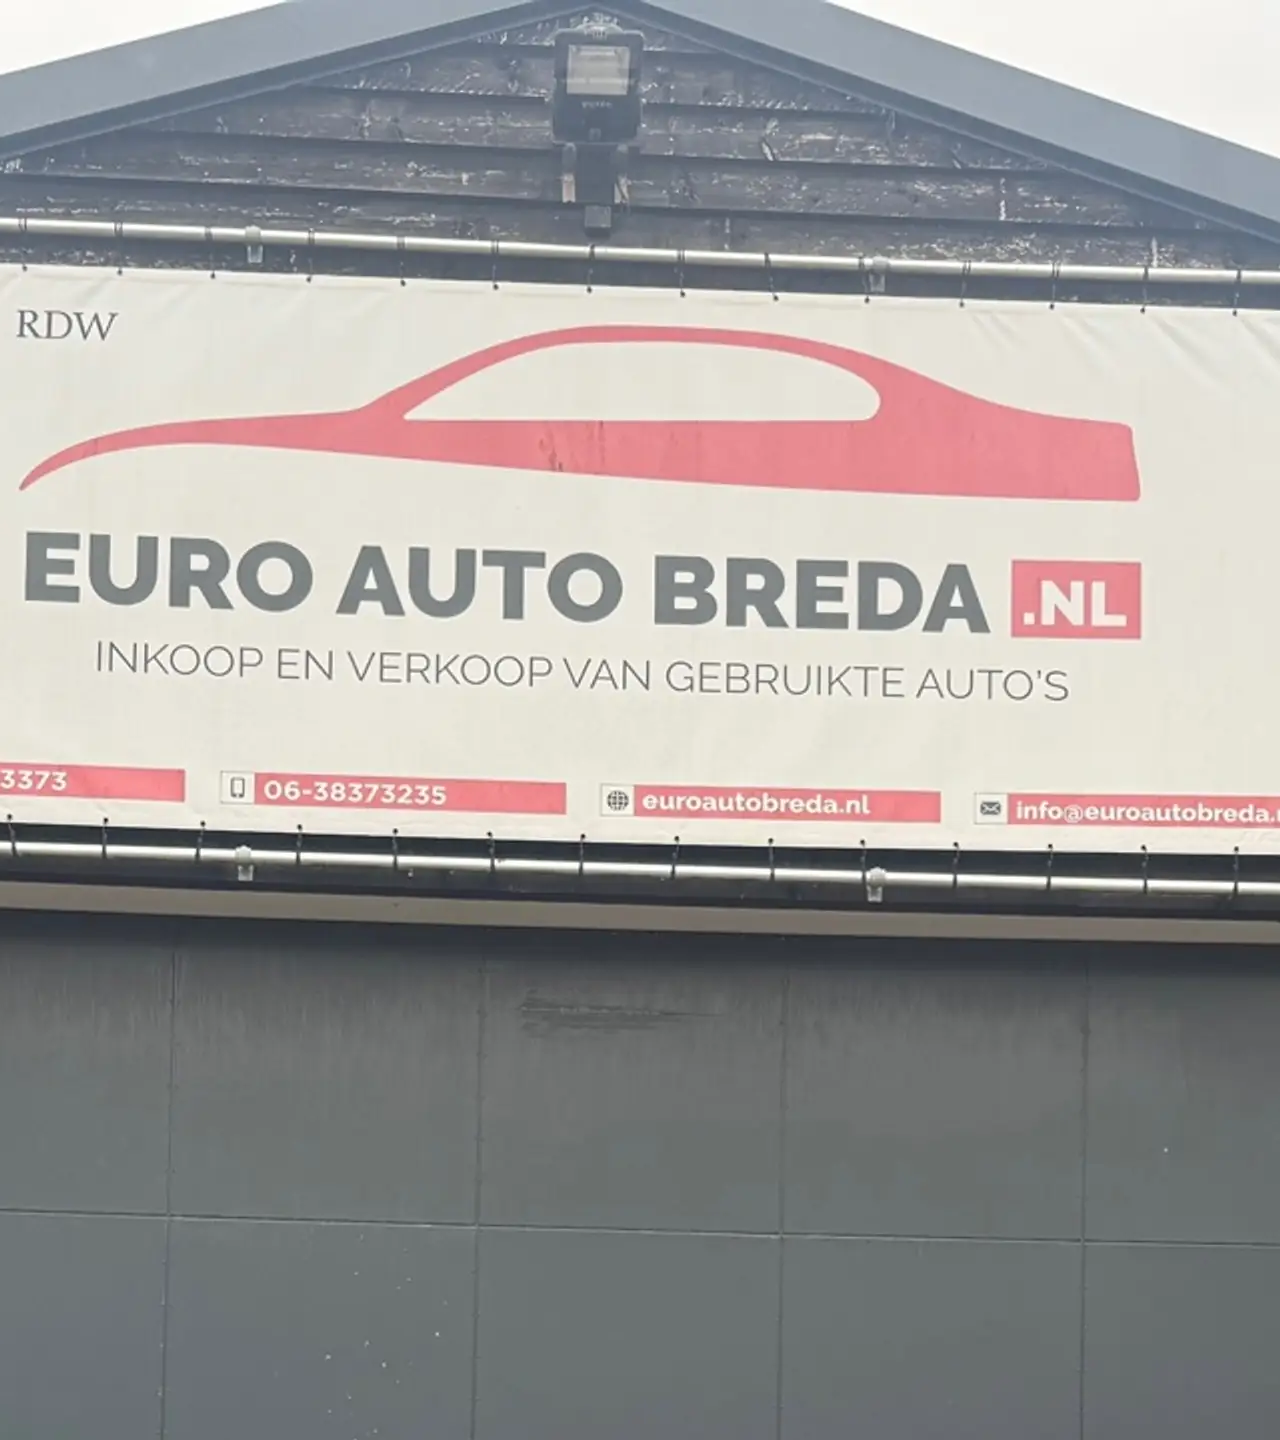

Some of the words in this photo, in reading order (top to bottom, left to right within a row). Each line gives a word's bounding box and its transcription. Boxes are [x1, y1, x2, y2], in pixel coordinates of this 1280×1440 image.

[16, 309, 118, 341] RDW
[24, 531, 313, 612] EURO
[335, 545, 623, 622] AUTO
[654, 554, 991, 634] BREDA
[1022, 579, 1128, 627] .NL
[95, 640, 263, 678] INKOOP
[277, 647, 334, 681] EN
[346, 651, 553, 688] VERKOOP
[562, 657, 650, 691] VAN
[665, 660, 905, 698] GEBRUIKTE
[915, 667, 1070, 701] AUTO'S
[263, 779, 448, 805] 06-38373235
[642, 792, 871, 815] euroautobreda.nl
